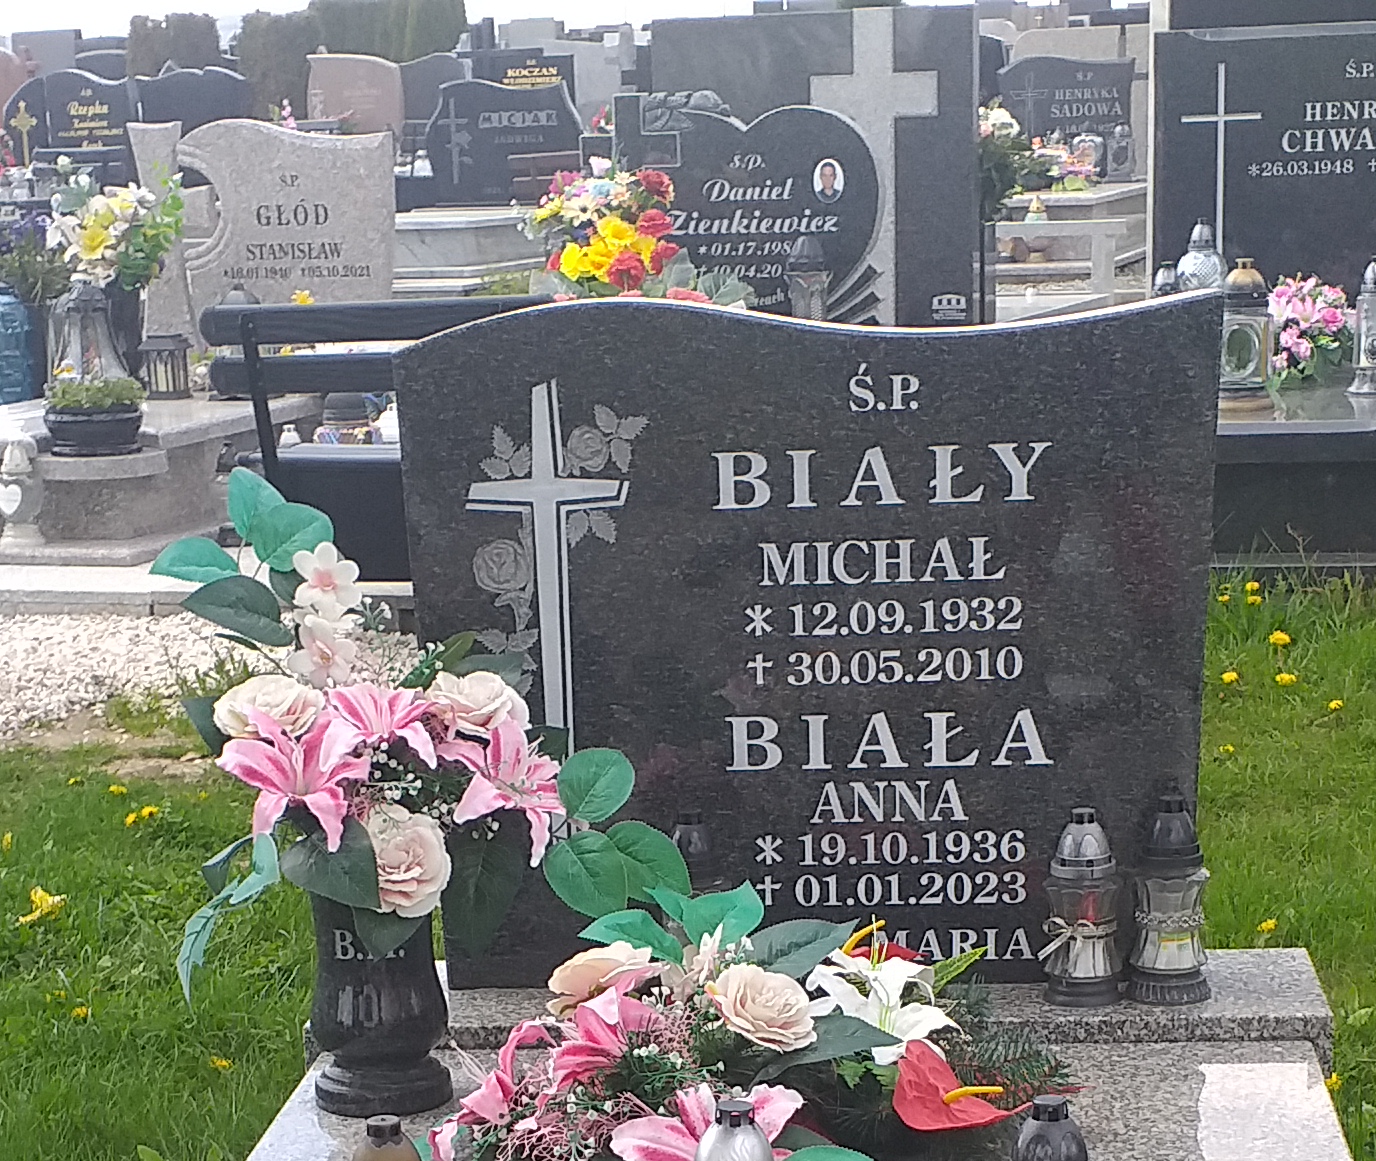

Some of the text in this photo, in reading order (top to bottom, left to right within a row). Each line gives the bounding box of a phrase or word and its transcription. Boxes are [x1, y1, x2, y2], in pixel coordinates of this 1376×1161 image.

[1345, 58, 1375, 78] Ś.P.
[479, 110, 558, 128] MICIAK
[1050, 101, 1123, 118] SADOWA
[1261, 158, 1354, 177] 26.03.1948
[702, 177, 794, 202] Daniel
[256, 198, 329, 227] GŁÓD
[666, 209, 840, 236] Zienkiewicz
[246, 242, 343, 261] STANISŁAW
[849, 363, 920, 412] Ś.P.
[711, 441, 1053, 511] BIAŁY
[758, 536, 1007, 587] MICHAŁ
[788, 596, 1024, 637] 12.09.1932
[787, 645, 1024, 687] 30.05.2010
[725, 708, 1055, 772] BIAŁA
[809, 778, 970, 824] ANNA
[797, 829, 1026, 866] 19.10.1936
[794, 871, 1027, 908] 01.01.2023
